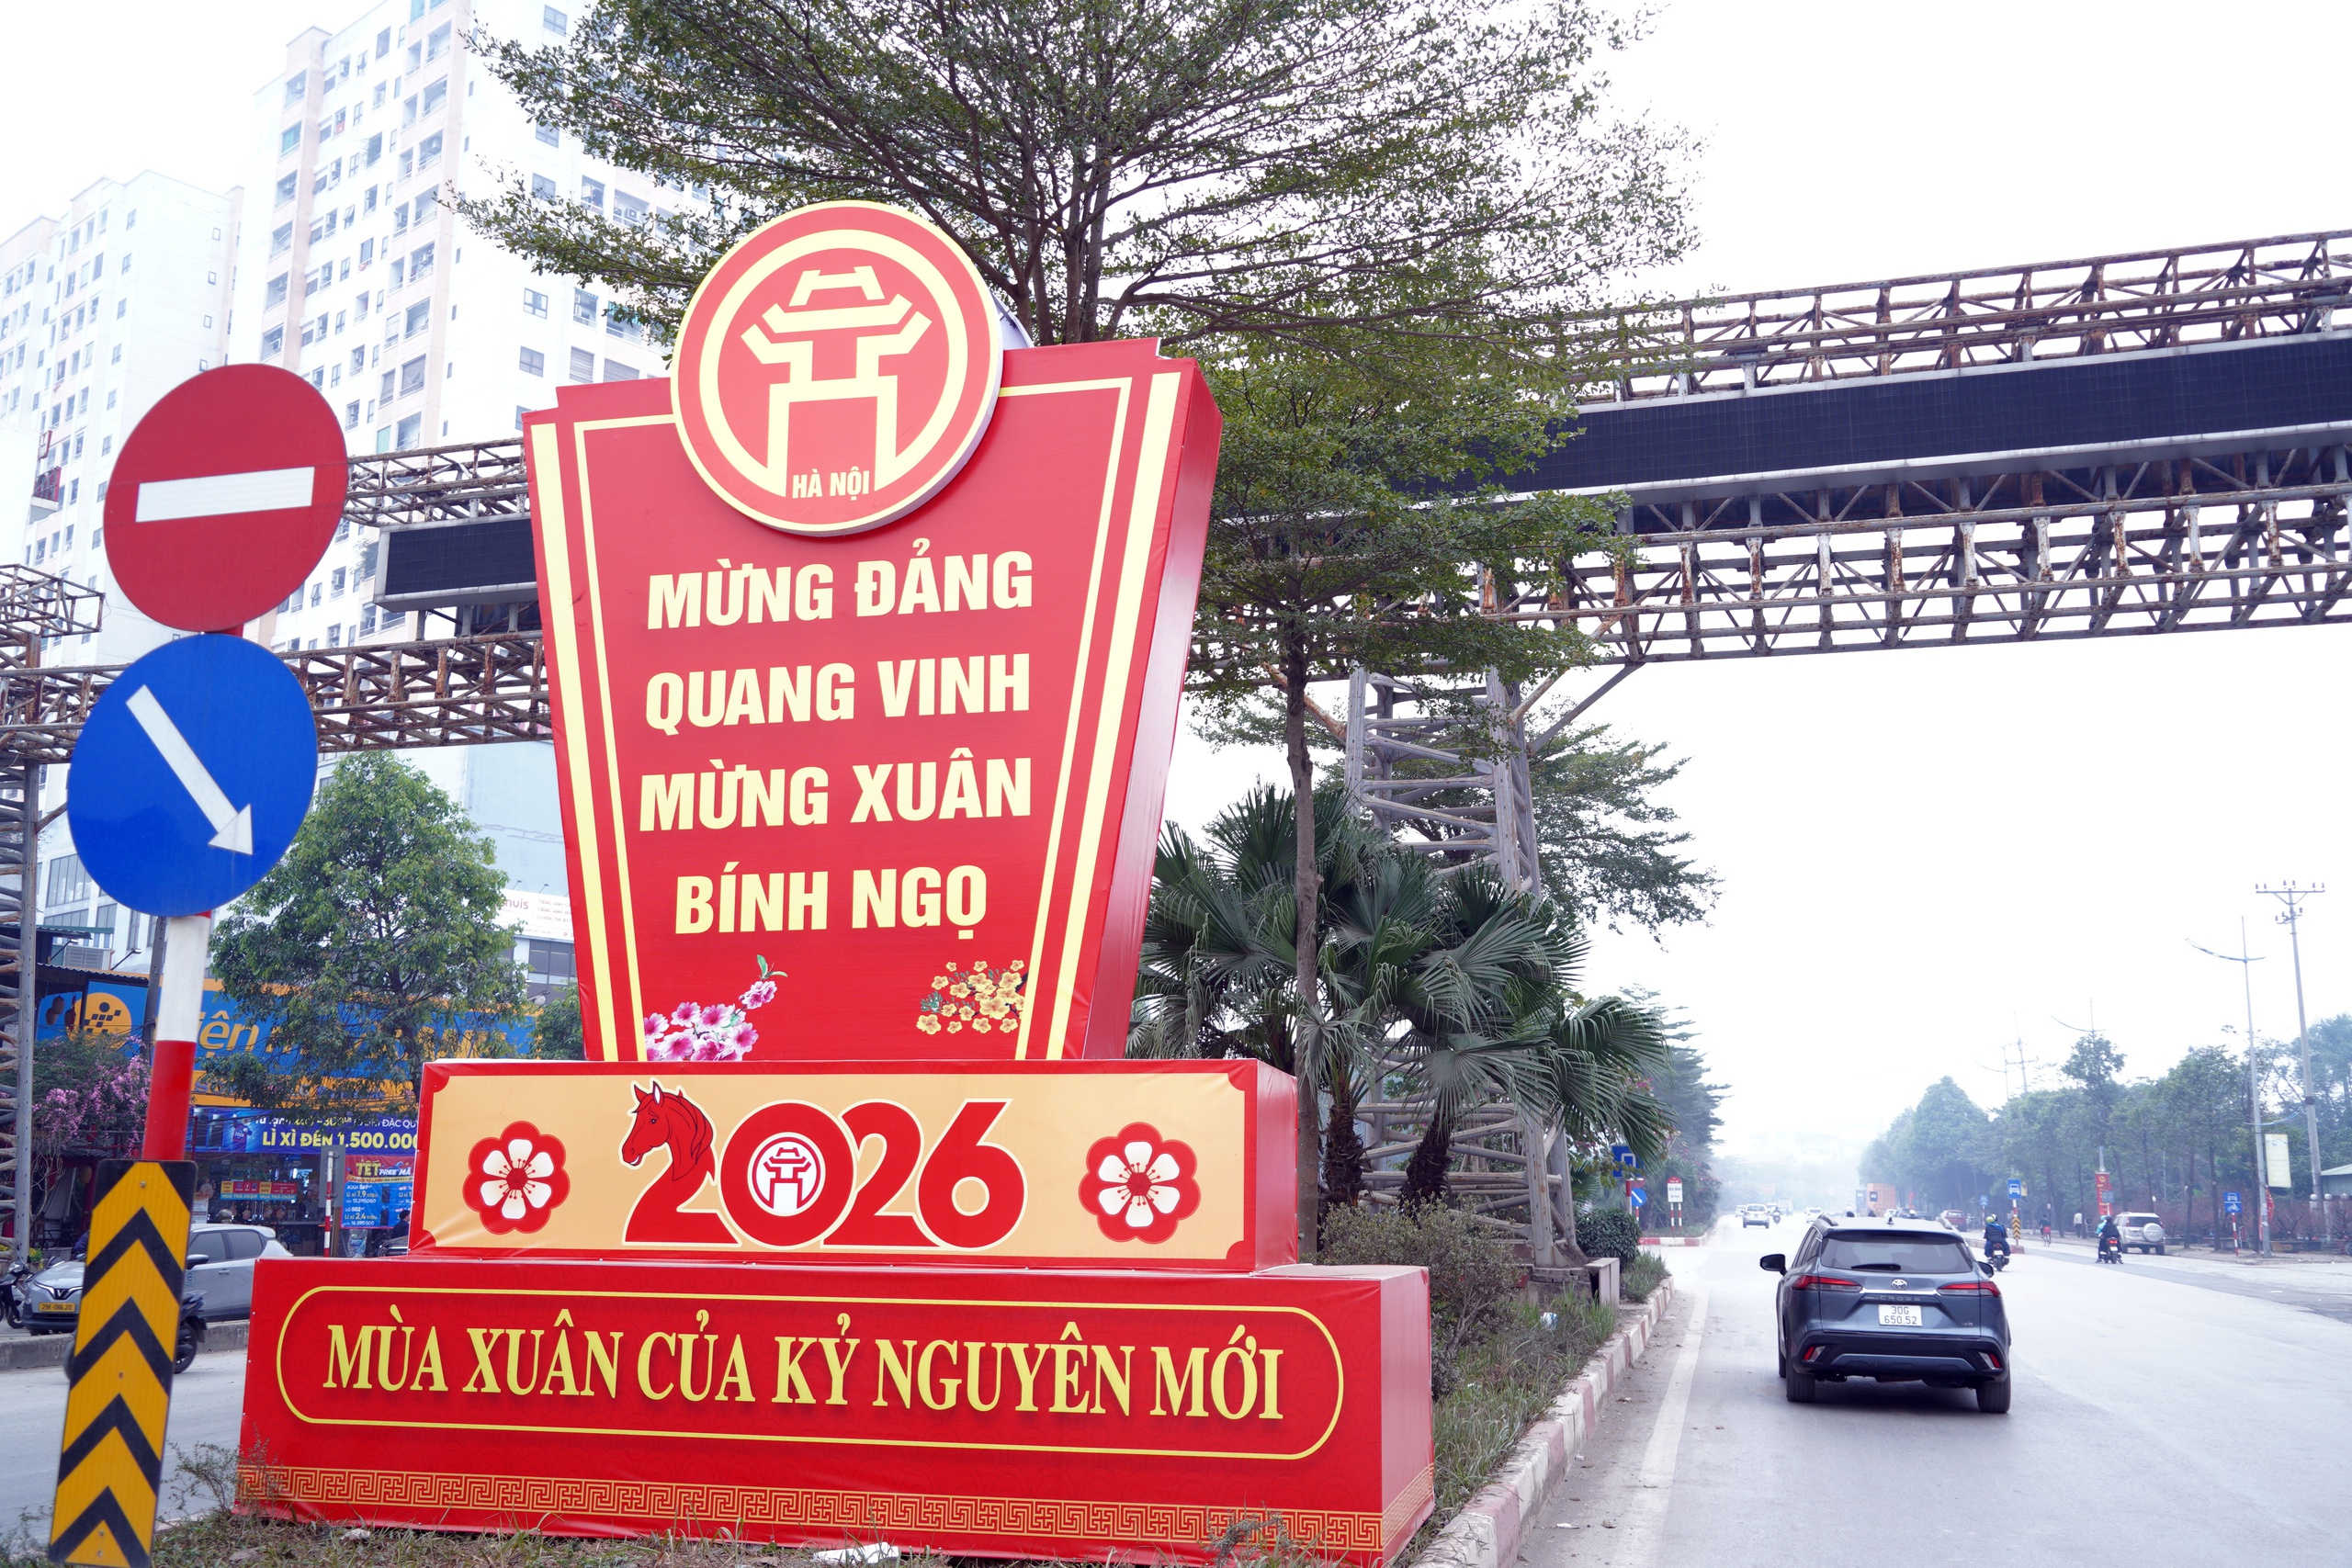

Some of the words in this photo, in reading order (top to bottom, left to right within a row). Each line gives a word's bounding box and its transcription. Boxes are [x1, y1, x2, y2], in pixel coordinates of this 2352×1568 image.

[792, 468, 823, 499] HÀ
[830, 466, 870, 501] NỘI
[648, 558, 833, 629] MỪNG
[854, 537, 1033, 616] ĐẢNG
[646, 662, 854, 736] QUANG
[877, 653, 1030, 717] VINH
[639, 759, 829, 831] MỪNG
[850, 747, 1031, 823] XUÂN
[675, 861, 828, 934] BÍNH
[852, 865, 987, 940] NGỌ
[263, 1127, 276, 1146] LÌ
[279, 1128, 296, 1146] XÌ
[300, 1129, 333, 1147] ĐẾN
[382, 1118, 401, 1129] ĐẶC
[402, 1119, 418, 1129] QU
[623, 1078, 1028, 1252] 2026
[1884, 1315, 1917, 1325] 650.52
[1892, 1306, 1910, 1315] 30G
[322, 1303, 449, 1392] MÙA
[462, 1308, 625, 1399] XUÂN
[638, 1309, 756, 1403] CỦA
[771, 1313, 861, 1405] KỶ
[872, 1321, 1136, 1417] NGUYÊN
[1150, 1324, 1284, 1420] MỚI
